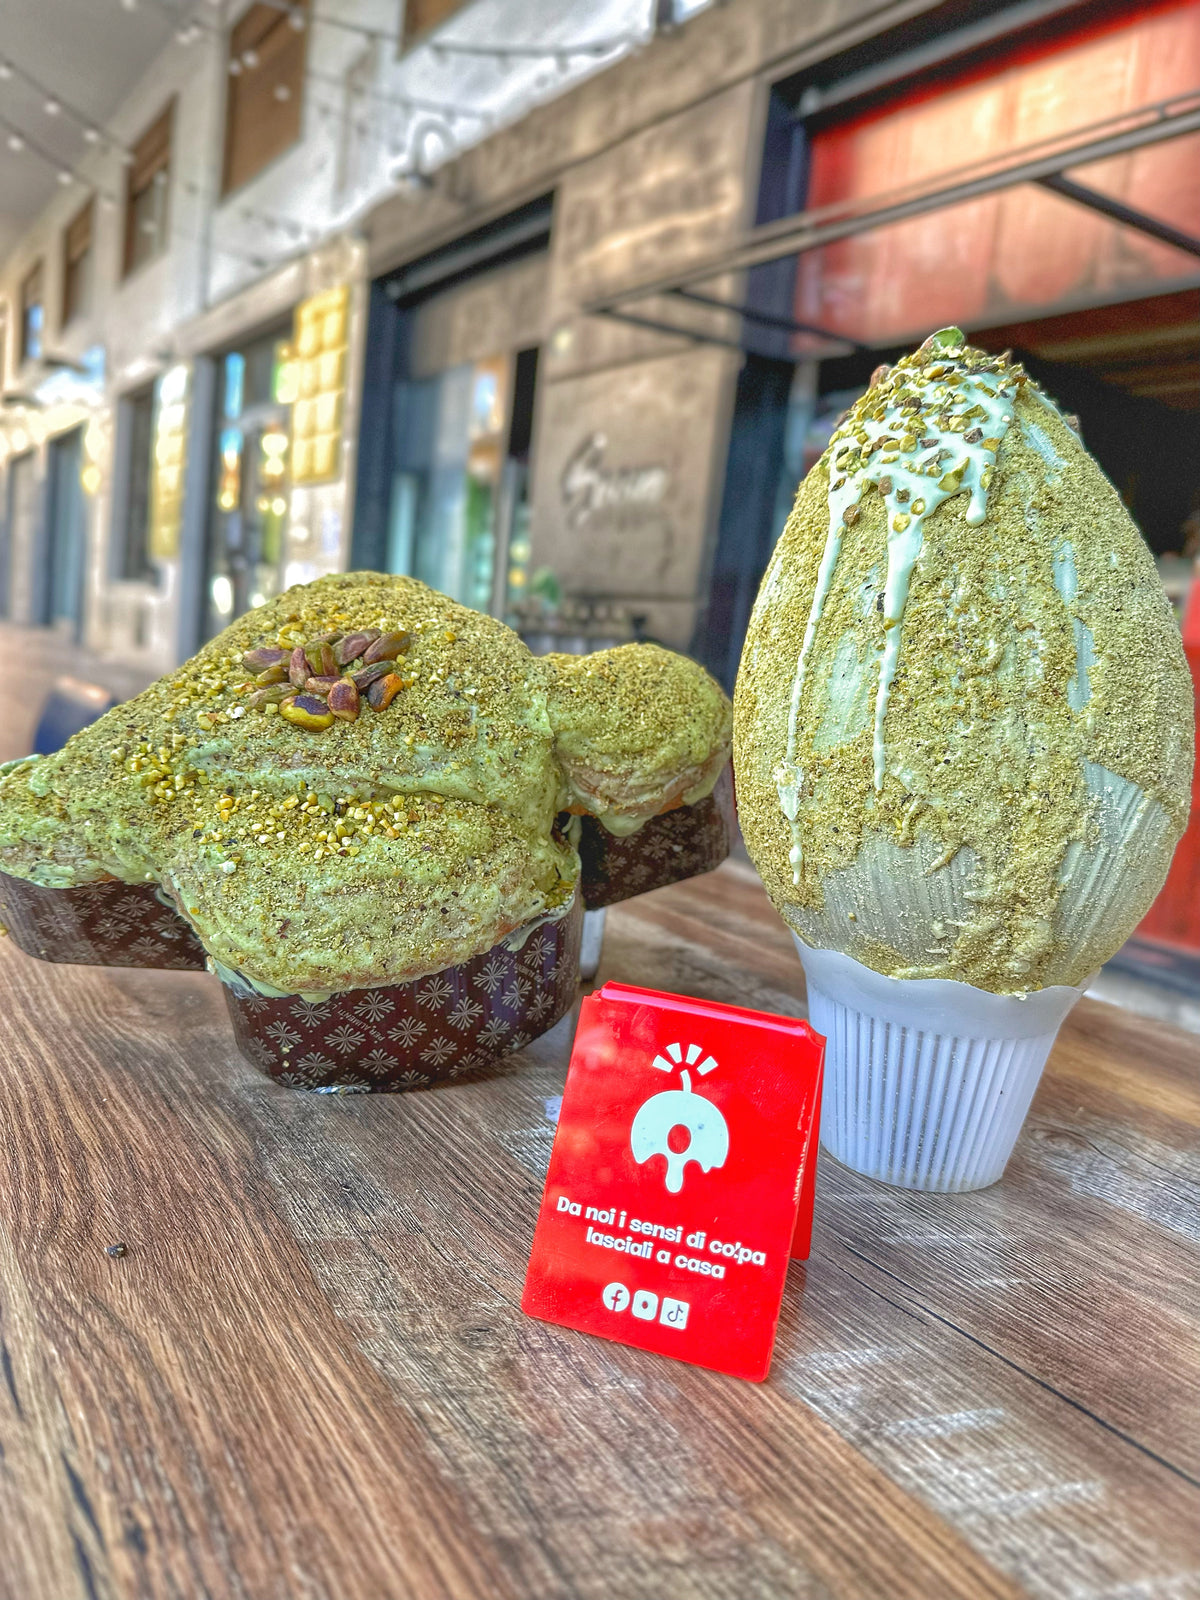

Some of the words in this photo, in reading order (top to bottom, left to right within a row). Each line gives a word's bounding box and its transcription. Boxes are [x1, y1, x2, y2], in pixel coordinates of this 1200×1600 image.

[337, 1009, 371, 1031] ALIMENTI
[369, 1029, 386, 1041] PER
[557, 1196, 582, 1216] Da
[585, 1207, 616, 1225] noi
[618, 1210, 627, 1228] i
[629, 1218, 683, 1243] sensi
[686, 1231, 706, 1249] di
[586, 1226, 654, 1259] lasciali
[656, 1249, 671, 1264] a
[674, 1254, 726, 1279] casa
